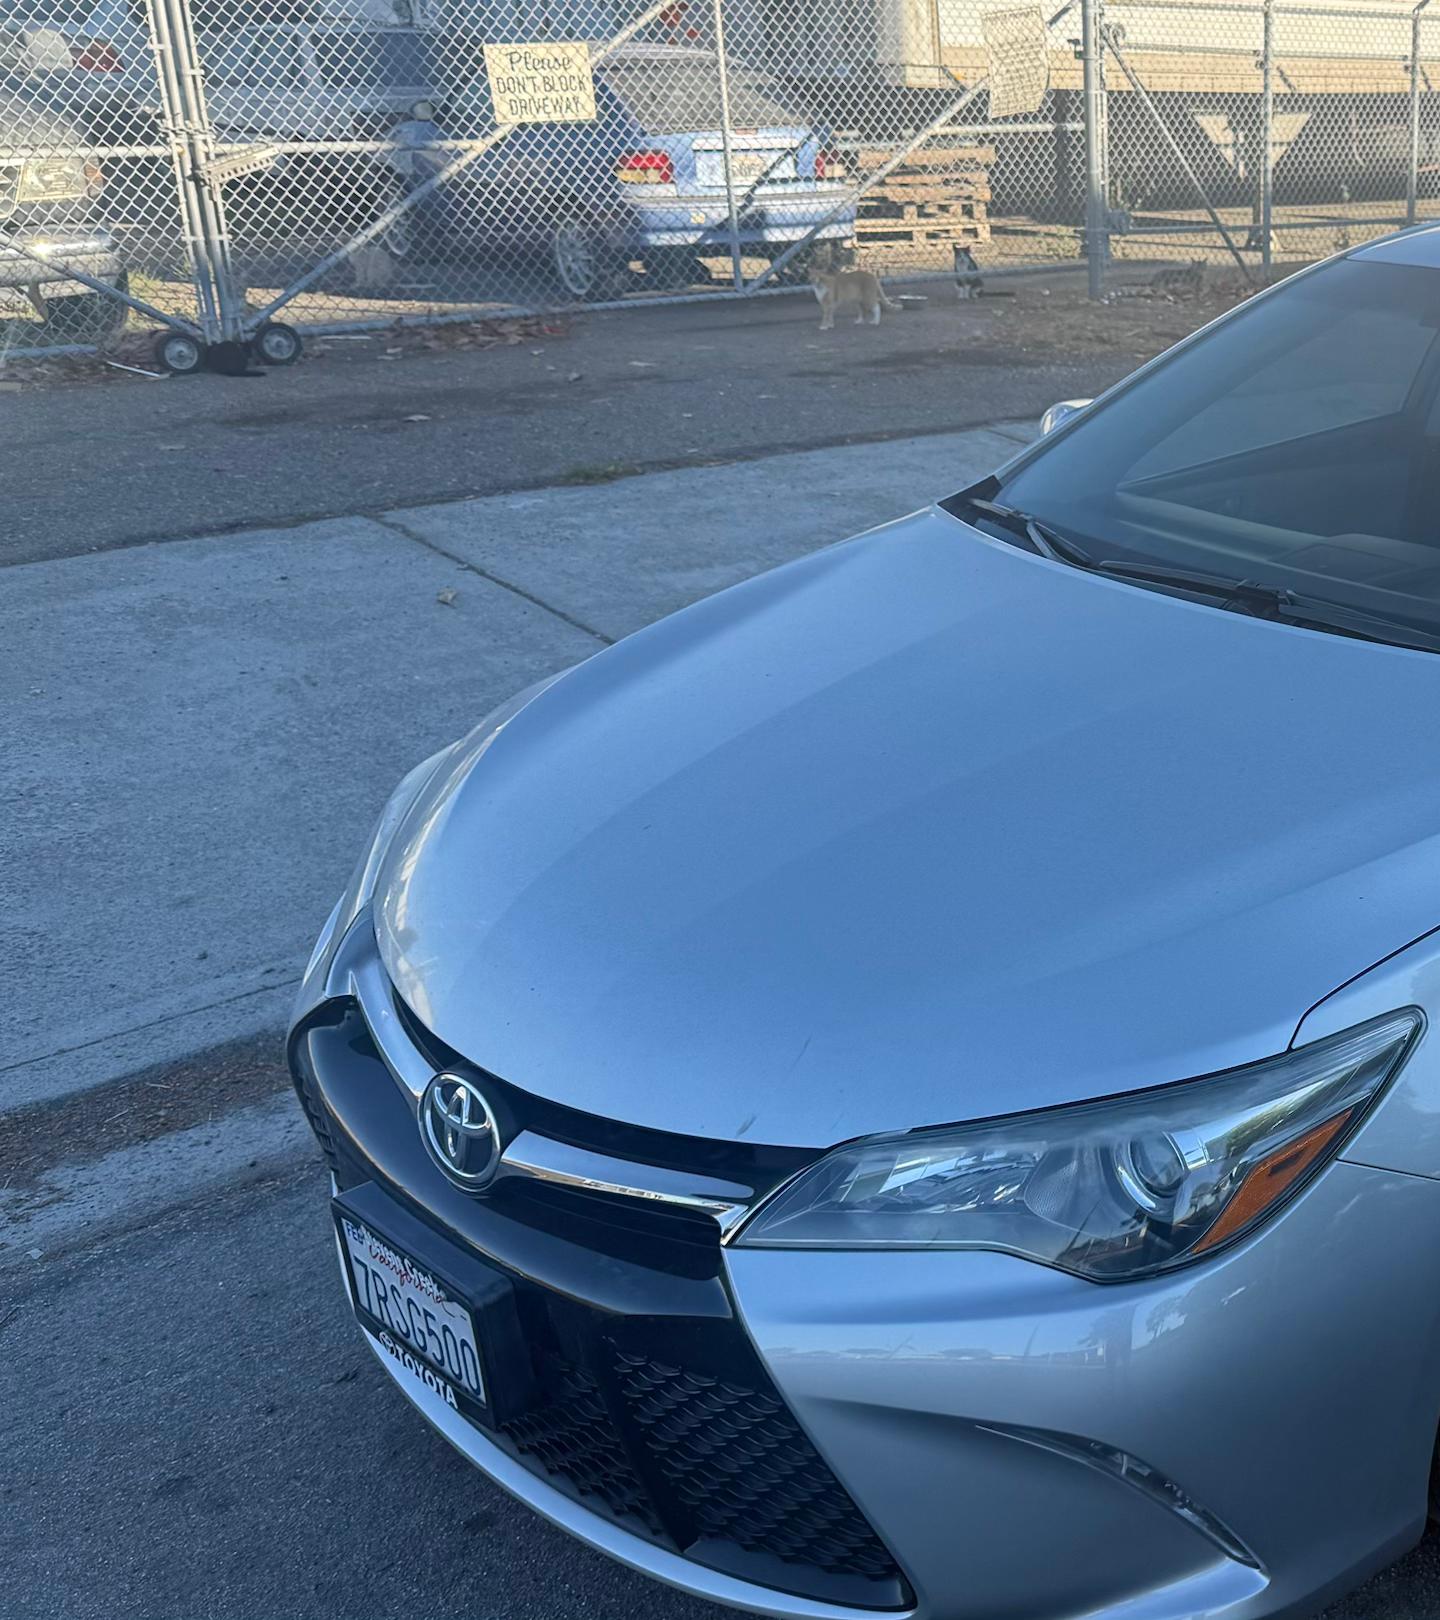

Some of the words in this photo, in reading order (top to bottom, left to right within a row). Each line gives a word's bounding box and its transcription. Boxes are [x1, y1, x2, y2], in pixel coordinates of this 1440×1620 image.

[506, 51, 572, 72] Please
[496, 76, 538, 94] DON'T
[543, 74, 588, 93] BLOCK
[509, 96, 580, 115] DRIVEWAY
[353, 1255, 482, 1397] 7RSG500
[394, 1345, 459, 1410] TOYOTA
